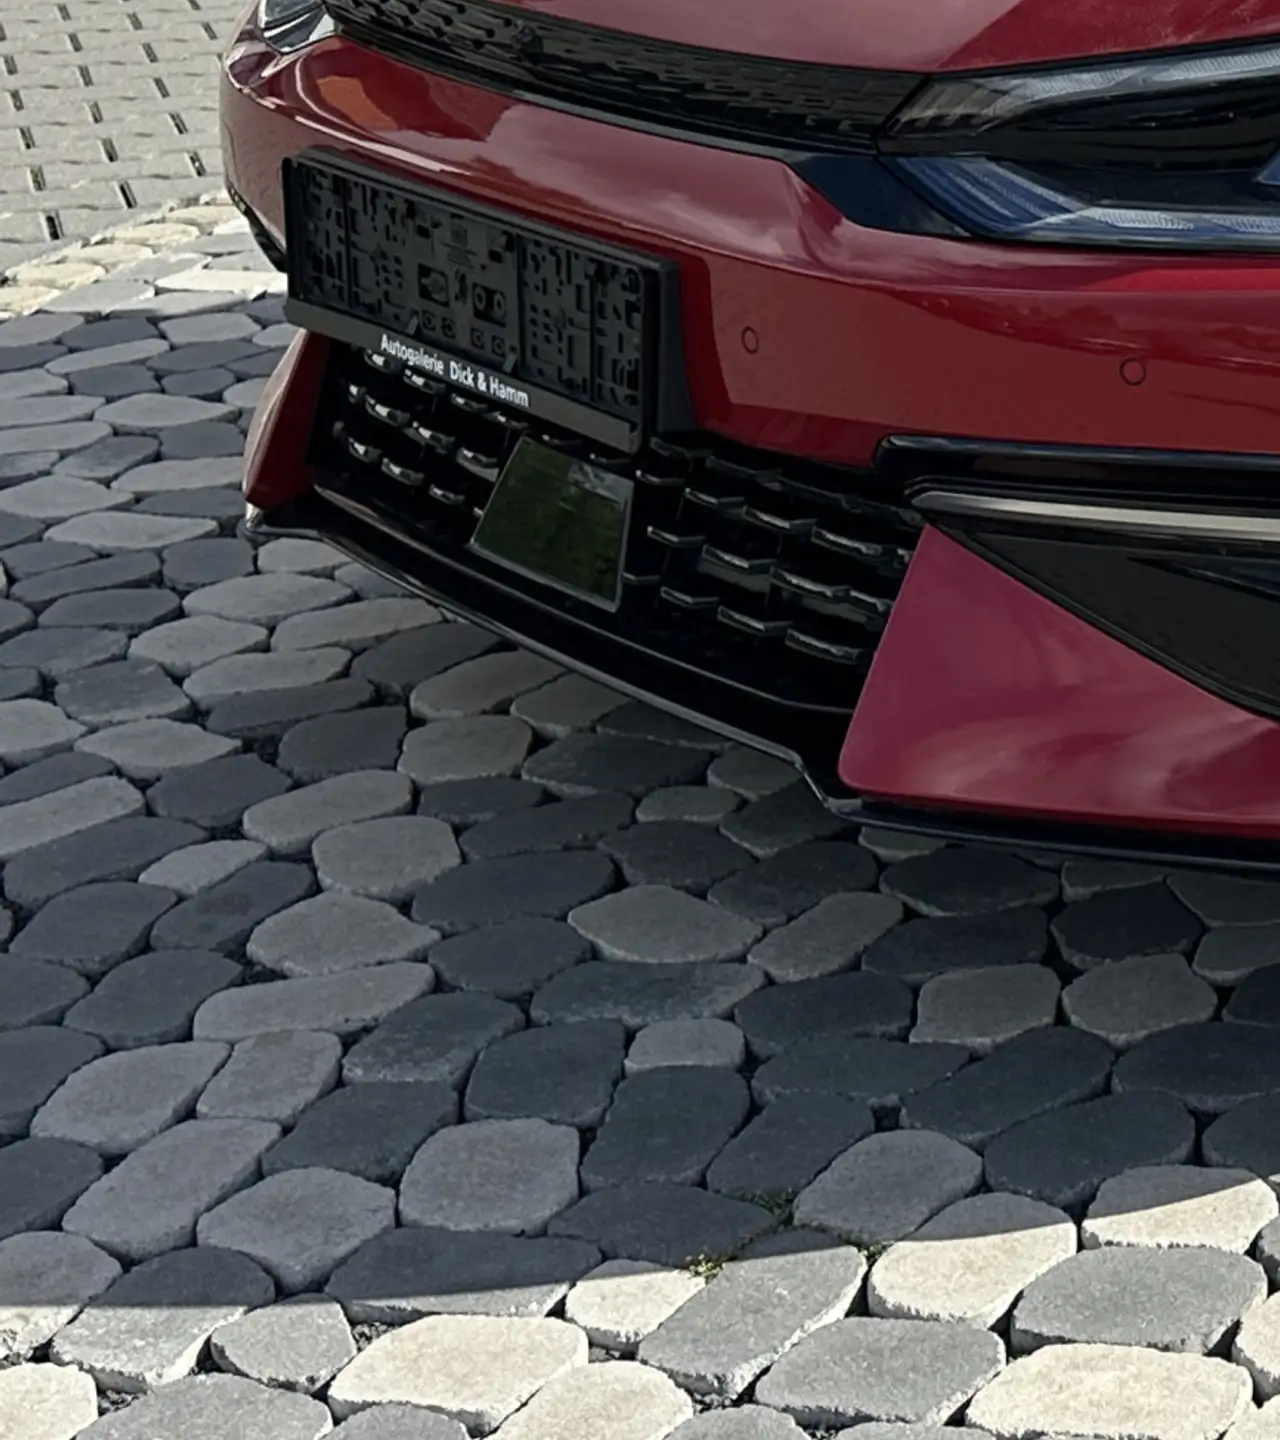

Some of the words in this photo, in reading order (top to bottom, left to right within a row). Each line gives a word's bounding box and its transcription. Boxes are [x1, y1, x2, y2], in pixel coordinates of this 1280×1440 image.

[380, 333, 445, 376] Autogalerie
[449, 360, 475, 388] Dick
[477, 370, 488, 392] &
[489, 375, 530, 409] Hamm
